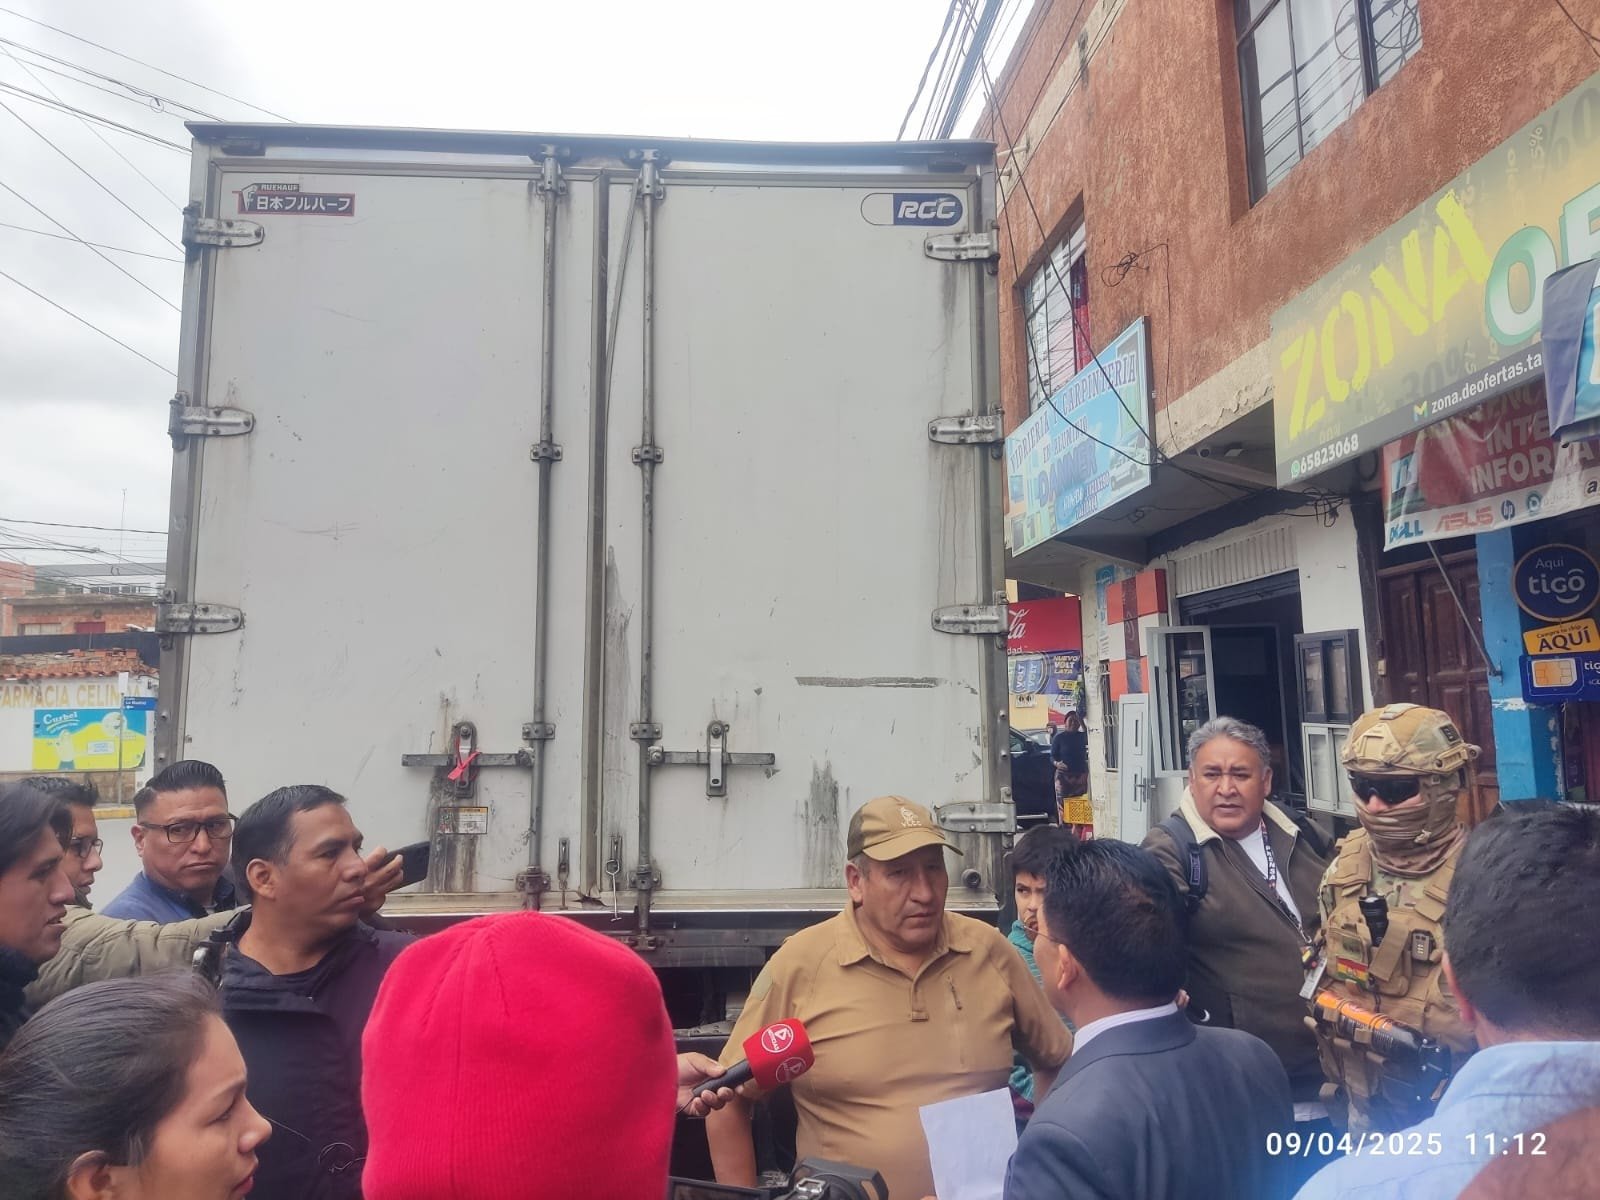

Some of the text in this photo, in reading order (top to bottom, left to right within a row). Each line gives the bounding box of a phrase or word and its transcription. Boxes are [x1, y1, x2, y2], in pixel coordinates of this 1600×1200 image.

[256, 196, 351, 211] 日本フルハーフ
[1279, 189, 1493, 441] ZONA
[1062, 353, 1137, 416] CARPINTERIA
[1431, 351, 1543, 415] zona.deofertas.ta
[1300, 433, 1359, 474] 65823068
[1435, 505, 1494, 533] ASUS
[1539, 626, 1591, 652] AQUÍ
[1054, 661, 1076, 669] VOLT
